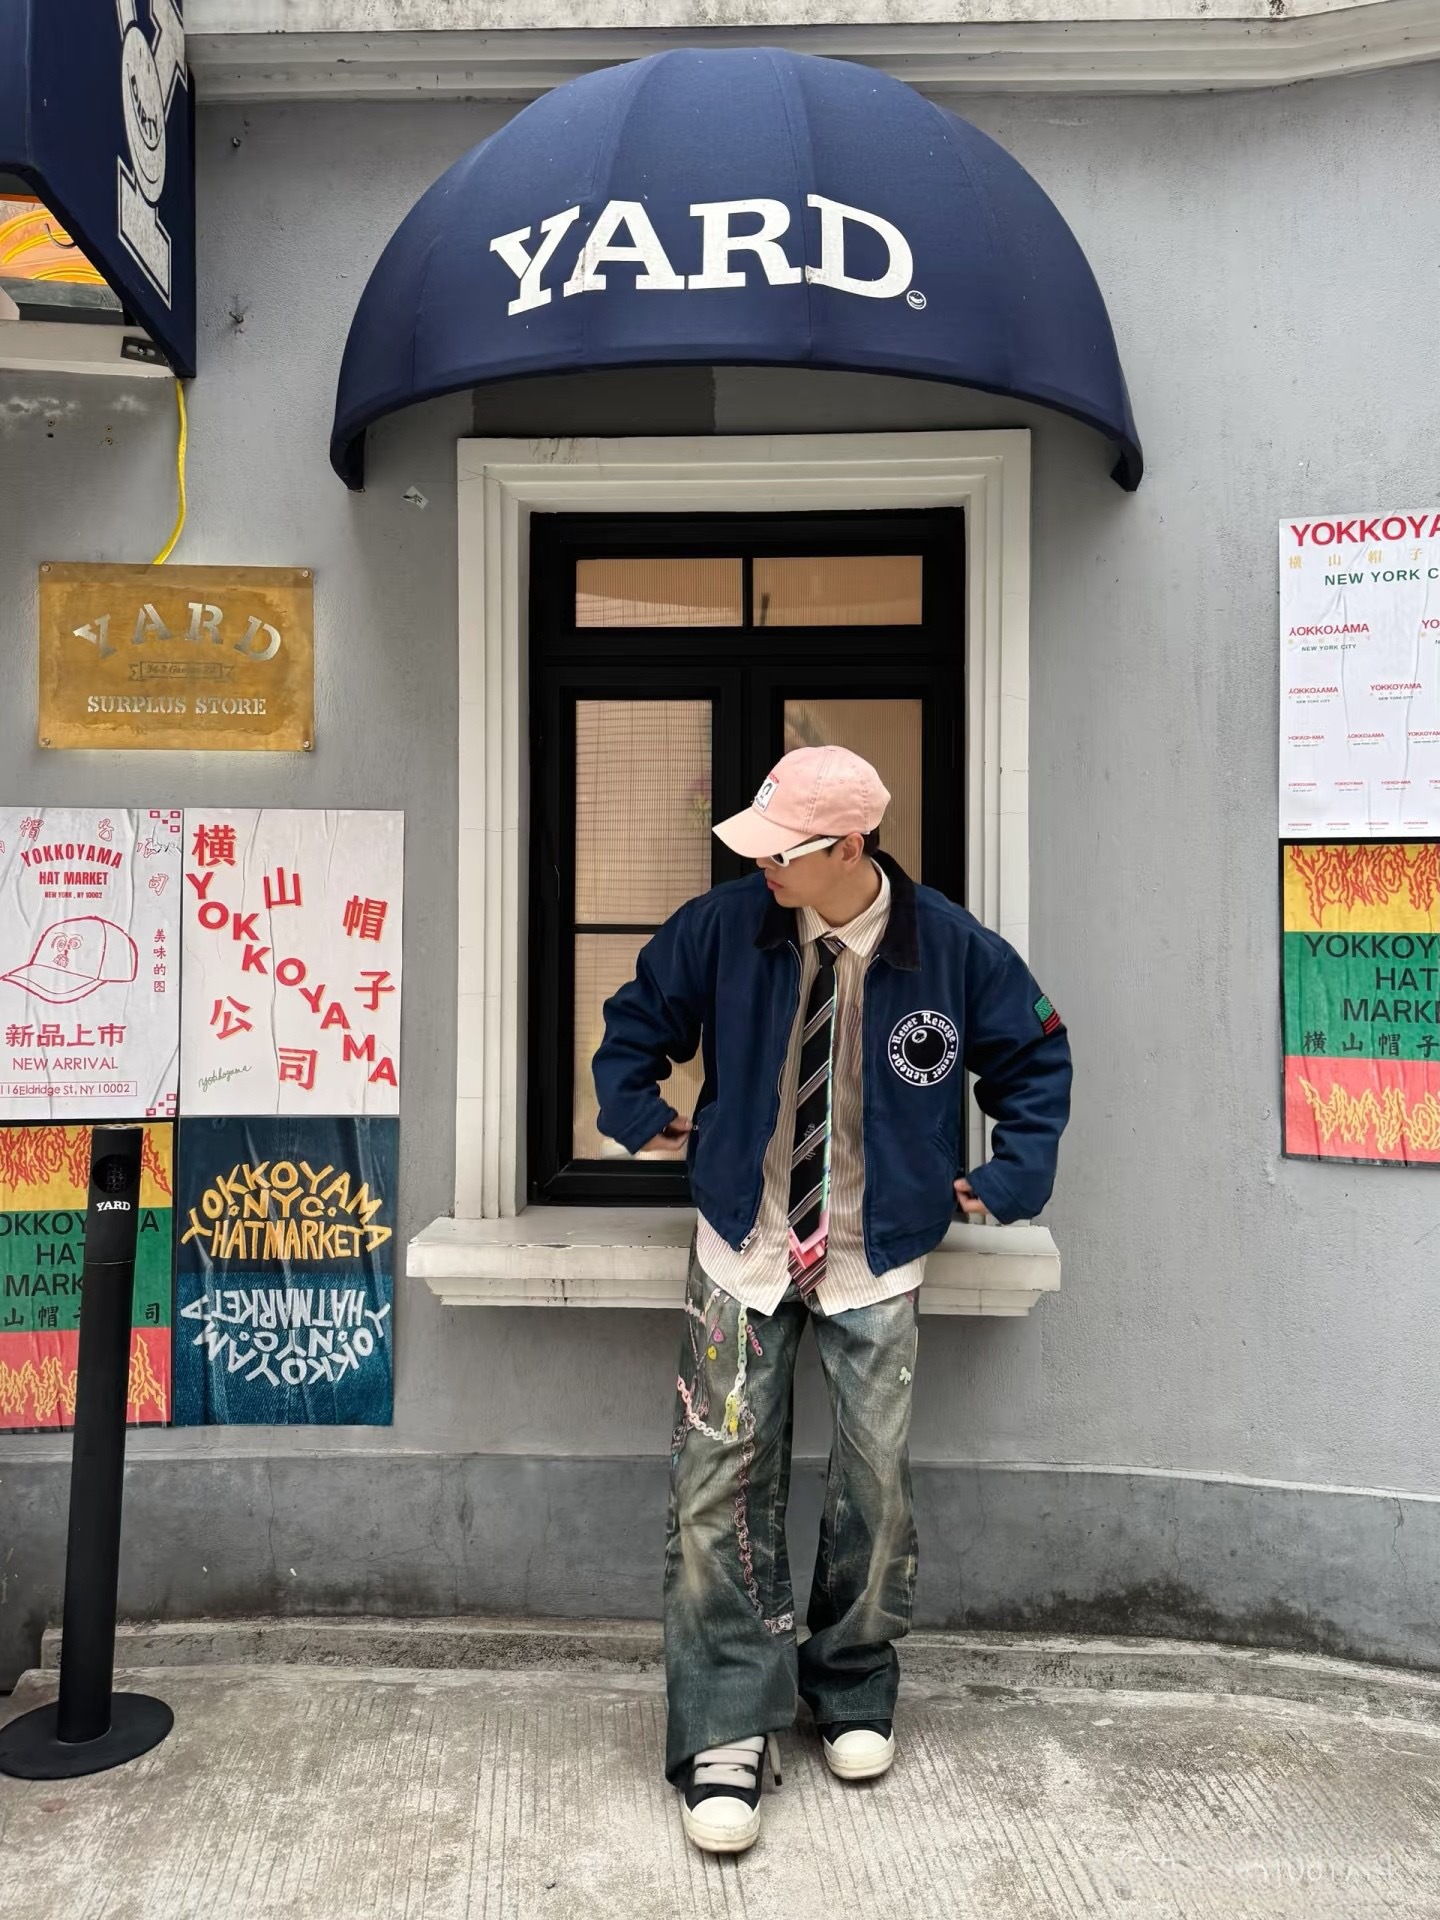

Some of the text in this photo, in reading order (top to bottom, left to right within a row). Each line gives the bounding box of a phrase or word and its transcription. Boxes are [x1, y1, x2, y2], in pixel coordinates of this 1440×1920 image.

[490, 194, 914, 316] YARD
[1325, 572, 1364, 586] NEW
[1371, 569, 1420, 583] YORK
[73, 602, 282, 662] YARD
[87, 695, 266, 715] SURPLUS STORE
[20, 843, 123, 869] YOKKOYAMA
[192, 823, 237, 868] 横
[39, 871, 109, 886] HAT MARKET
[263, 866, 303, 910] 山
[45, 891, 57, 899] NEW
[342, 894, 389, 941] 帽
[1304, 934, 1440, 961] YOKKOY
[354, 970, 396, 1012] 子
[1375, 967, 1439, 992] HAT
[209, 995, 254, 1041] 公
[5, 1023, 127, 1048] 新品上市
[1303, 1030, 1439, 1059] 横山帽子
[12, 1056, 119, 1071] NEW ARRIVAL
[277, 1046, 319, 1091] 司
[79, 1084, 95, 1095] NY
[98, 1083, 131, 1095] 10002
[96, 1200, 131, 1213] YARD
[180, 1160, 393, 1253] YOKKOYAMA
[5, 1273, 86, 1298] MARK
[180, 1293, 391, 1387] YOKKOYAMA
